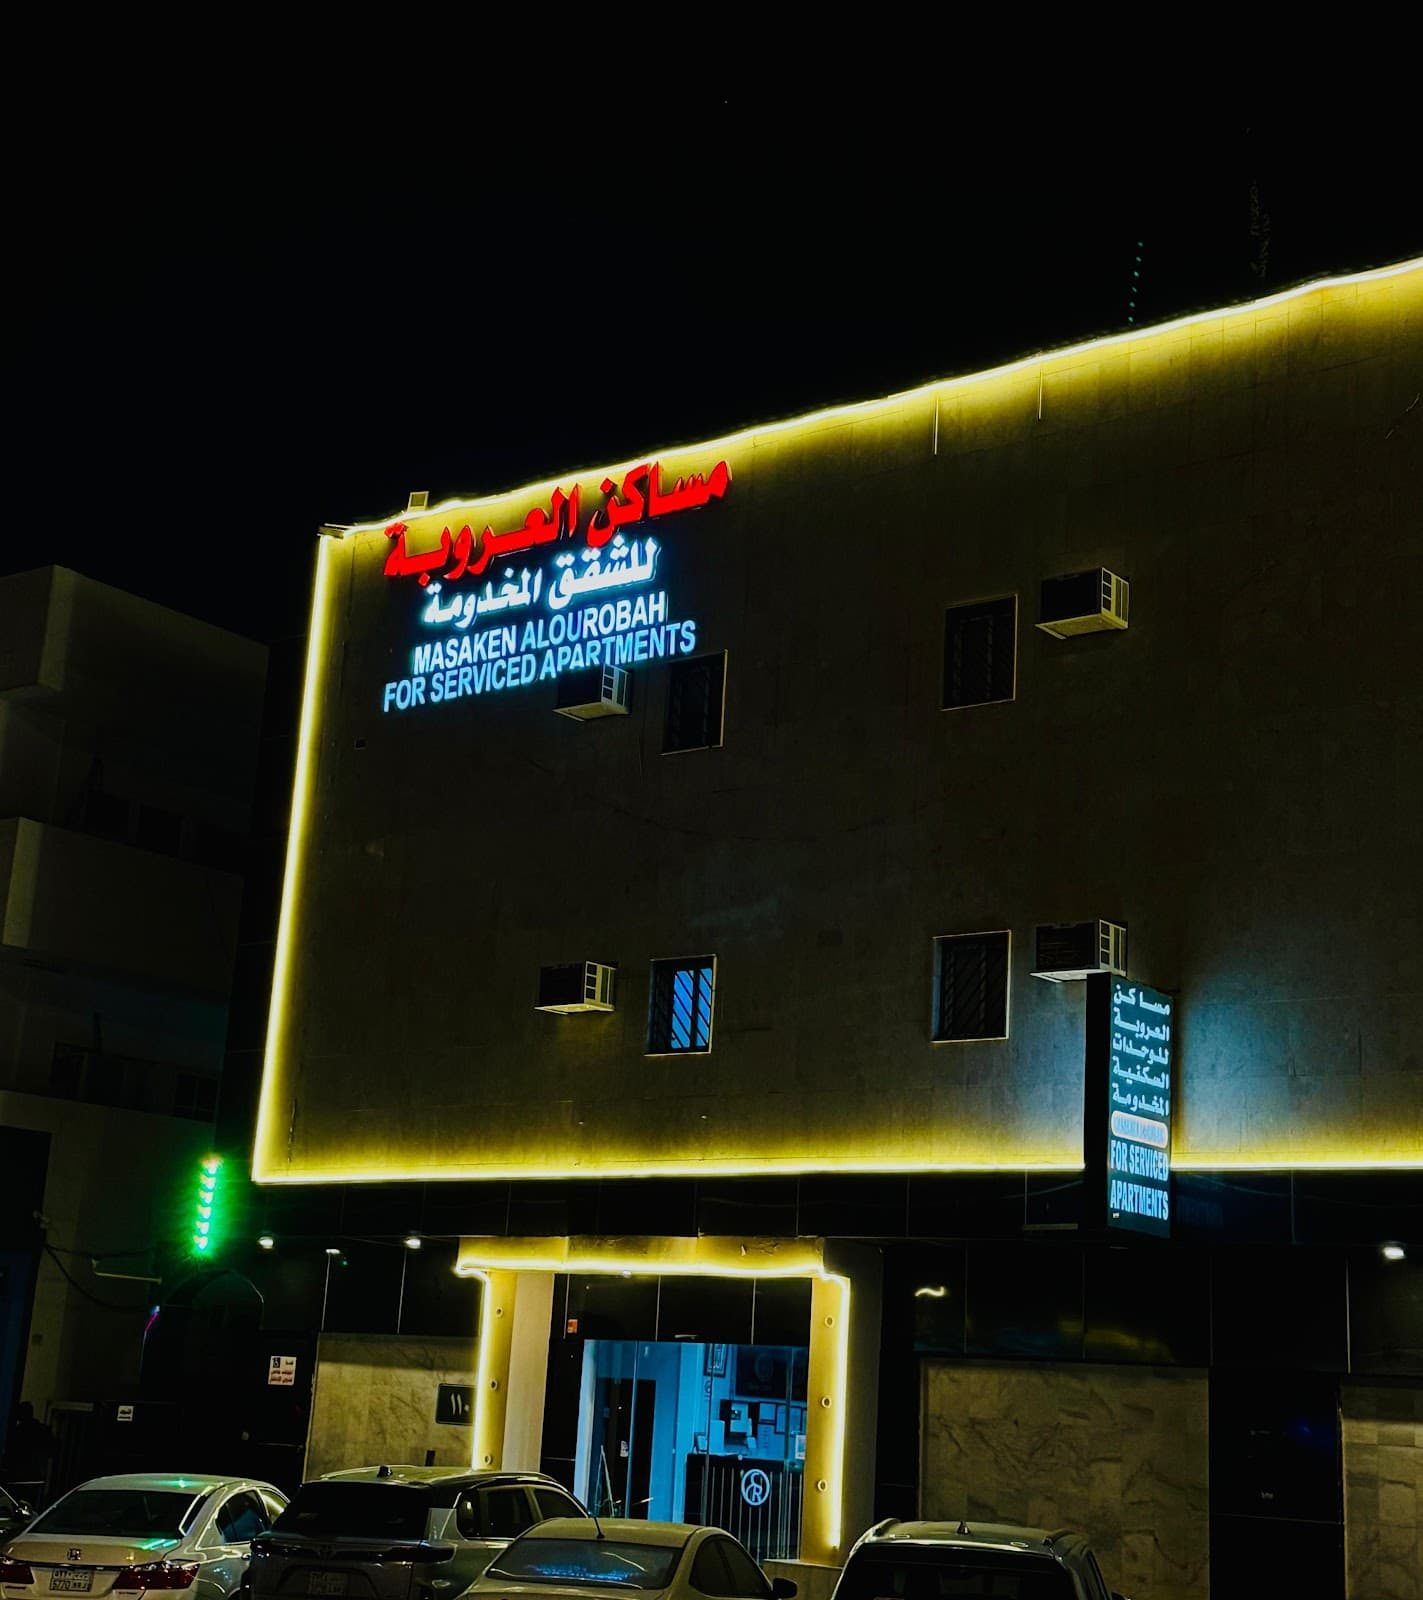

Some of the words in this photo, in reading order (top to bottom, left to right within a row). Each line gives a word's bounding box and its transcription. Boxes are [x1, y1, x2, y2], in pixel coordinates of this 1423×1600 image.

[586, 460, 731, 546] مساكن
[384, 482, 581, 586] العروبة
[548, 533, 661, 609] للشقق
[422, 567, 543, 627] المخدومة
[413, 625, 516, 676] MASAKEN
[520, 591, 668, 651] ALOUROBAH
[383, 678, 426, 712] FOR
[429, 656, 536, 703] SERVICED
[538, 620, 697, 679] APARTMENTS
[1113, 984, 1171, 1016] مساكن
[1113, 1006, 1170, 1042] العروبة
[1112, 1032, 1169, 1065] للوحدات
[1112, 1055, 1169, 1090] السكنية
[1112, 1082, 1169, 1116] المخدومة
[1110, 1140, 1128, 1173] FOR
[1129, 1144, 1169, 1182] SERVICED
[1110, 1179, 1169, 1221] APARTMENTS
